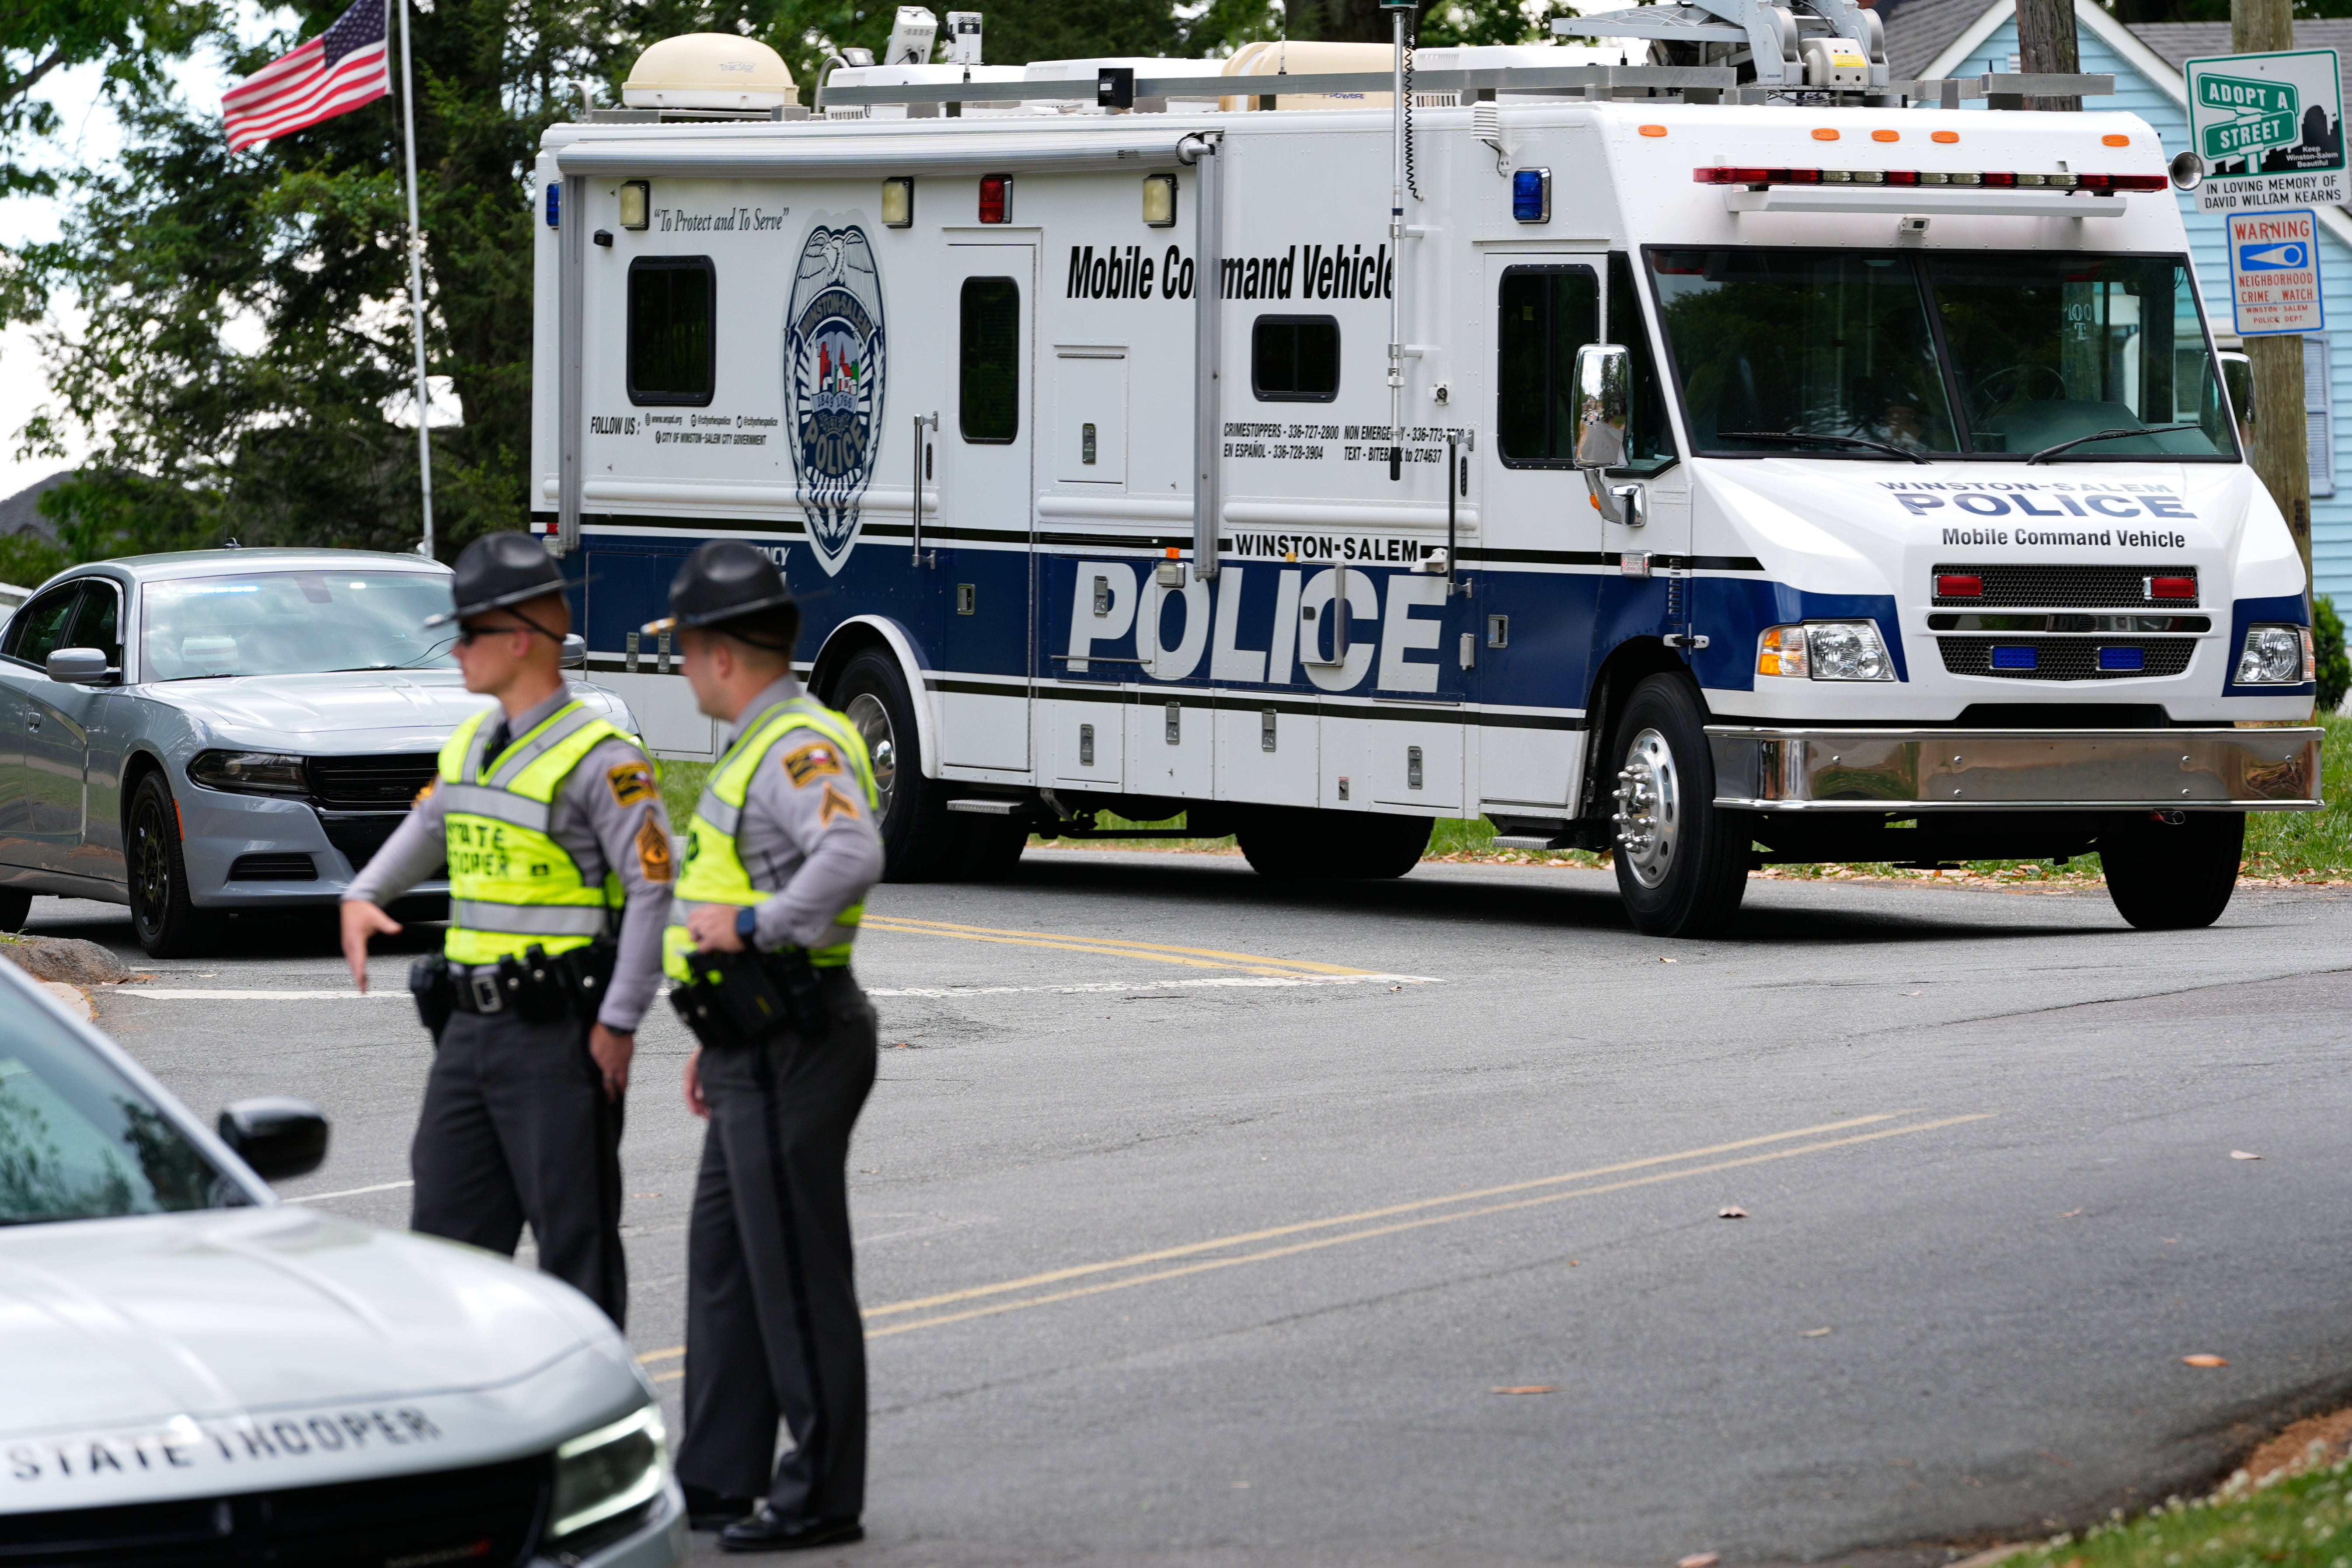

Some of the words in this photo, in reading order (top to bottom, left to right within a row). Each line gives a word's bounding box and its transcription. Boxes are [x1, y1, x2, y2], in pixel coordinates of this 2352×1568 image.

[2209, 83, 2266, 106] ADOPT
[2278, 91, 2289, 109] A
[2220, 120, 2280, 149] STREET
[2286, 152, 2338, 162] Winston-Salem
[2297, 160, 2329, 168] Beautiful
[2206, 183, 2218, 195] IN
[2224, 181, 2263, 193] LOVING
[2269, 177, 2317, 190] MEMORY
[2323, 175, 2337, 187] OF
[2206, 196, 2236, 209] DAVID
[2242, 192, 2289, 206] WILLIAM
[2295, 189, 2342, 203] KEARNS
[674, 209, 712, 231] Protect
[714, 207, 737, 231] and
[739, 208, 750, 230] To
[2234, 220, 2310, 240] WARNING
[1066, 246, 1154, 300] Mobile
[1163, 244, 1296, 300] Comand
[2239, 272, 2313, 287] NEIGHBORHOOD
[2241, 291, 2270, 303] CRIME
[2282, 289, 2313, 301] WATCH
[799, 293, 872, 341] WINSTON-SALEM
[818, 394, 834, 408] 1849
[836, 394, 852, 408] 1766
[591, 416, 623, 434] FOLLOW
[1224, 423, 1282, 438] CRIMESTOPPERS
[1288, 425, 1339, 439] 336-727-2800
[1344, 425, 1360, 440] NON
[1361, 425, 1406, 441] EMERGEY
[662, 432, 673, 443] CITY
[673, 432, 680, 443] OF
[722, 434, 733, 444] CITY
[734, 434, 767, 445] GOVERNMENT
[803, 415, 866, 475] POLICE
[1224, 443, 1234, 457] EN
[1235, 440, 1266, 458] ESPAÑOL
[1273, 444, 1324, 459] 336-728-3904
[1345, 446, 1362, 461] TEXT
[1368, 447, 1404, 462] BITEBK
[1405, 448, 1412, 462] to
[1414, 448, 1442, 463] 274637
[1875, 481, 2175, 493] WINSTON-SALEM
[1892, 493, 2198, 519] POLICE
[1236, 534, 1418, 562] WINSTON-SALEM
[1942, 528, 2008, 545] Mobile
[2015, 528, 2110, 546] Command
[2117, 530, 2186, 548] Vehicle
[1067, 561, 1448, 693] POLICE
[7, 1439, 193, 1481] STATE
[212, 1406, 442, 1463] TROOPER
